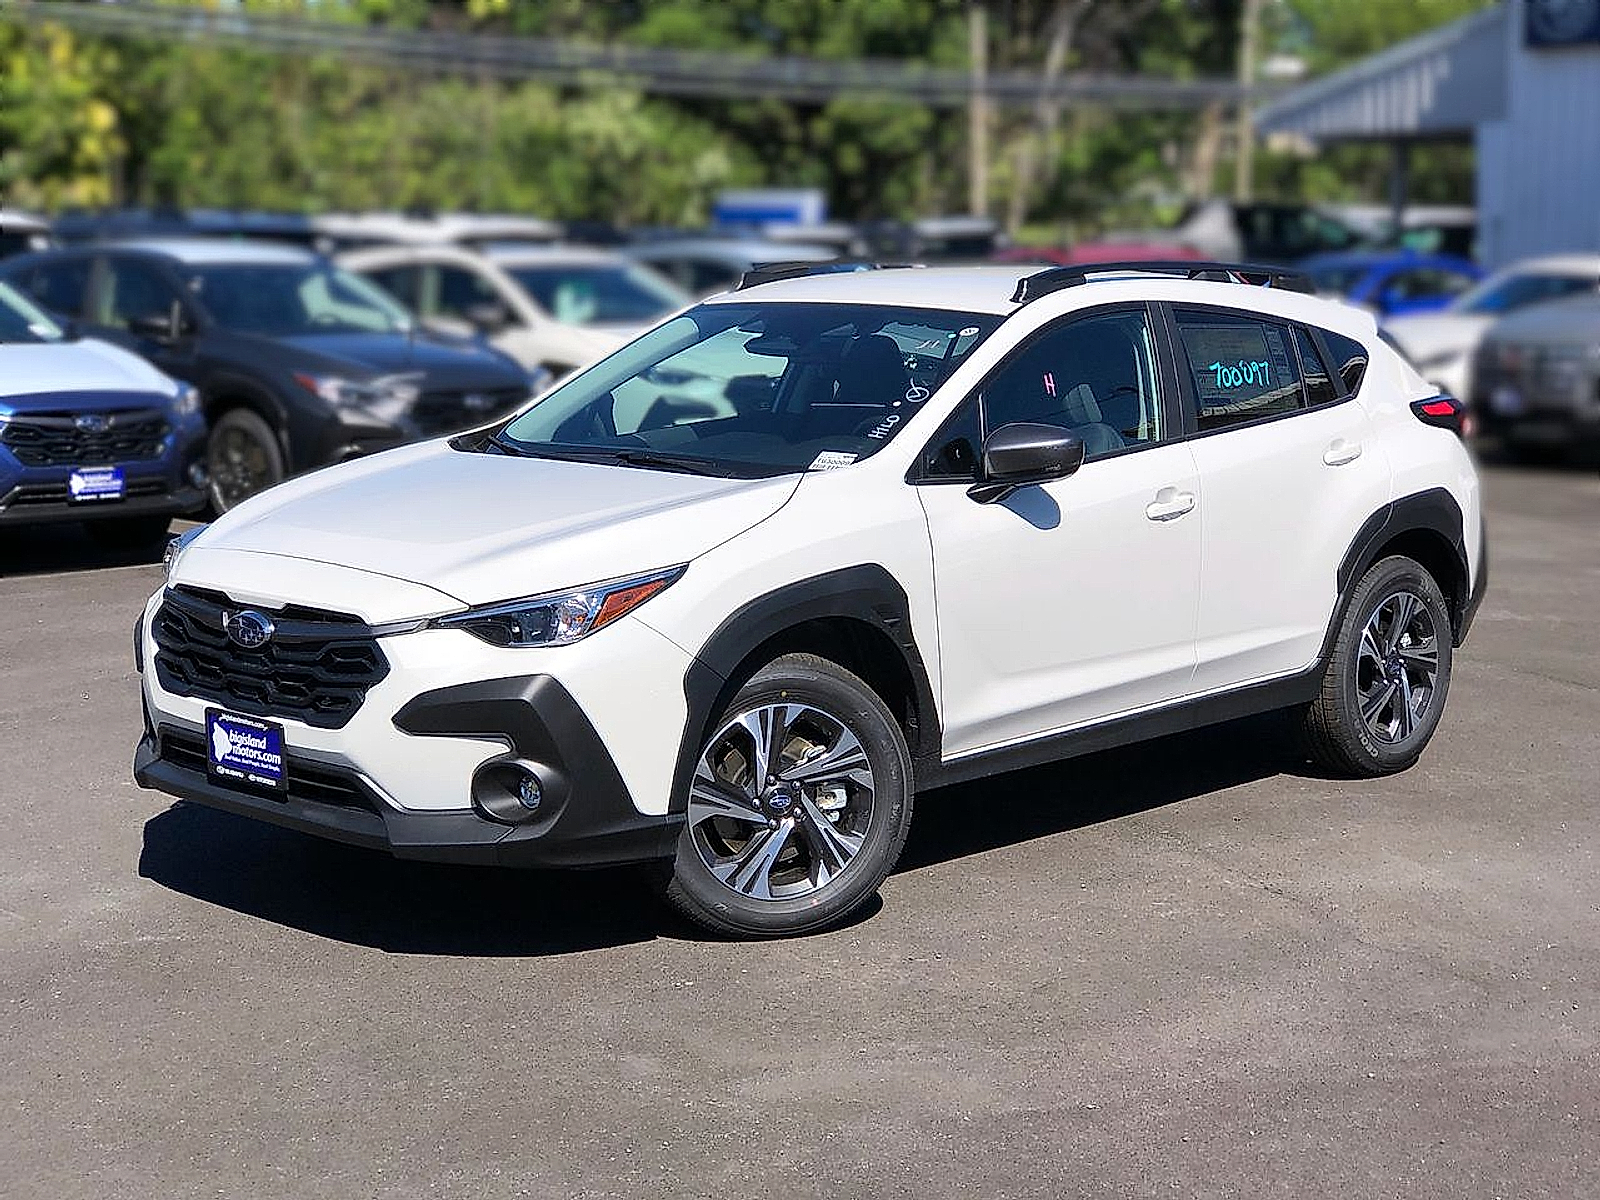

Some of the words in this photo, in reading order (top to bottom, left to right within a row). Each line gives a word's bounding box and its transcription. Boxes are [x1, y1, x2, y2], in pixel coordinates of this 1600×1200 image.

[867, 414, 901, 439] HILO
[229, 729, 267, 749] bigisland
[232, 745, 282, 765] motors.com
